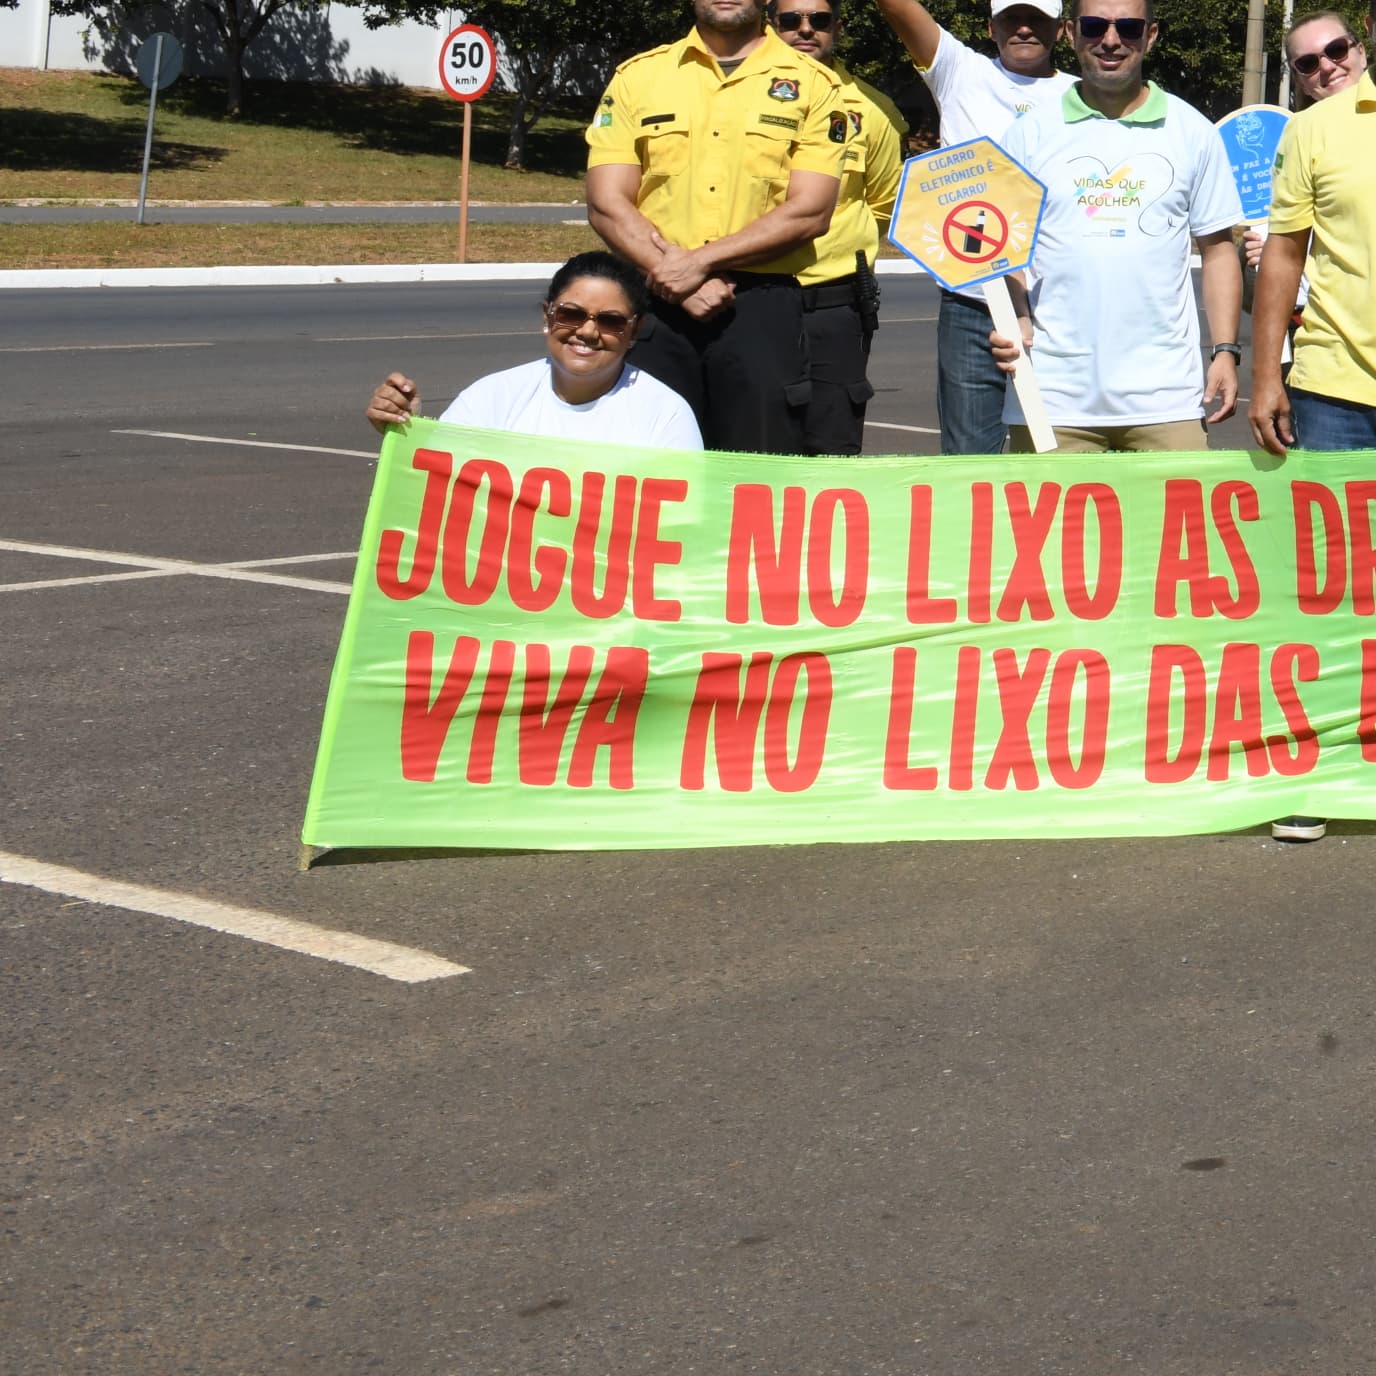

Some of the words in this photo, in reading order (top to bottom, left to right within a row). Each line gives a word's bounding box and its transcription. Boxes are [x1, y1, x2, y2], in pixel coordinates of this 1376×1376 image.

[451, 42, 484, 68] 50
[455, 76, 477, 85] km/h
[927, 149, 975, 171] CIGARRO
[919, 164, 985, 193] ELETRÔNICO
[986, 159, 994, 172] É
[1073, 177, 1113, 190] VIDAS
[1118, 178, 1147, 191] QUE
[937, 181, 988, 206] CIGARRO!
[1077, 195, 1141, 207] ACOLHEM
[376, 448, 689, 622] JOGUE
[713, 483, 870, 628] NO
[906, 481, 1123, 625] LIXO
[1154, 478, 1260, 620] AS
[400, 630, 649, 790] VIVA
[680, 651, 834, 793] NO
[883, 646, 1111, 791] LIXO
[1144, 642, 1321, 784] DAS
